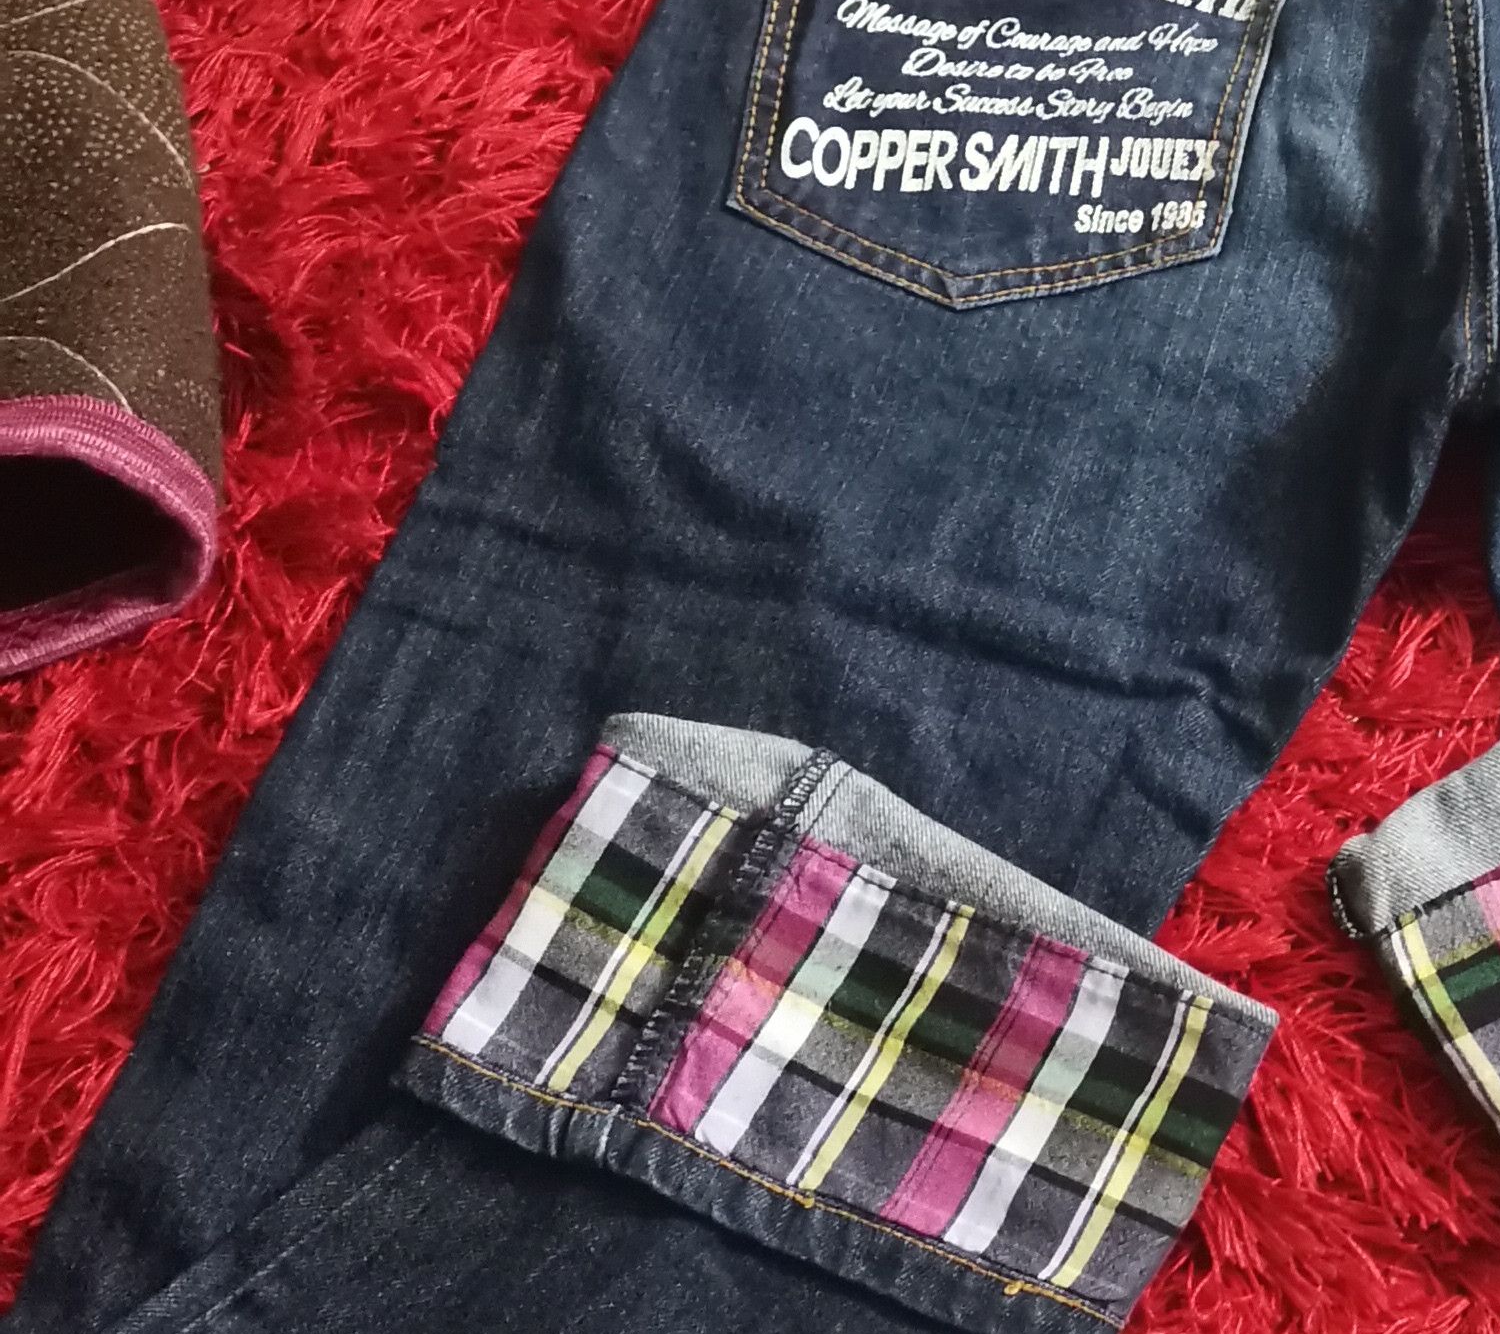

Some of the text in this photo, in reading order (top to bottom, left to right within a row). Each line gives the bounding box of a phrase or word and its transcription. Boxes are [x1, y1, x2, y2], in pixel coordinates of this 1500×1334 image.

[957, 20, 990, 50] of
[985, 17, 1092, 58] Courage
[1093, 30, 1147, 52] and
[901, 47, 1004, 77] Desire
[1004, 63, 1035, 80] to
[1034, 63, 1066, 82] be
[823, 76, 1194, 126] Let your Success Story Begin
[1109, 136, 1220, 182] JOUEX
[1074, 203, 1144, 234] Since
